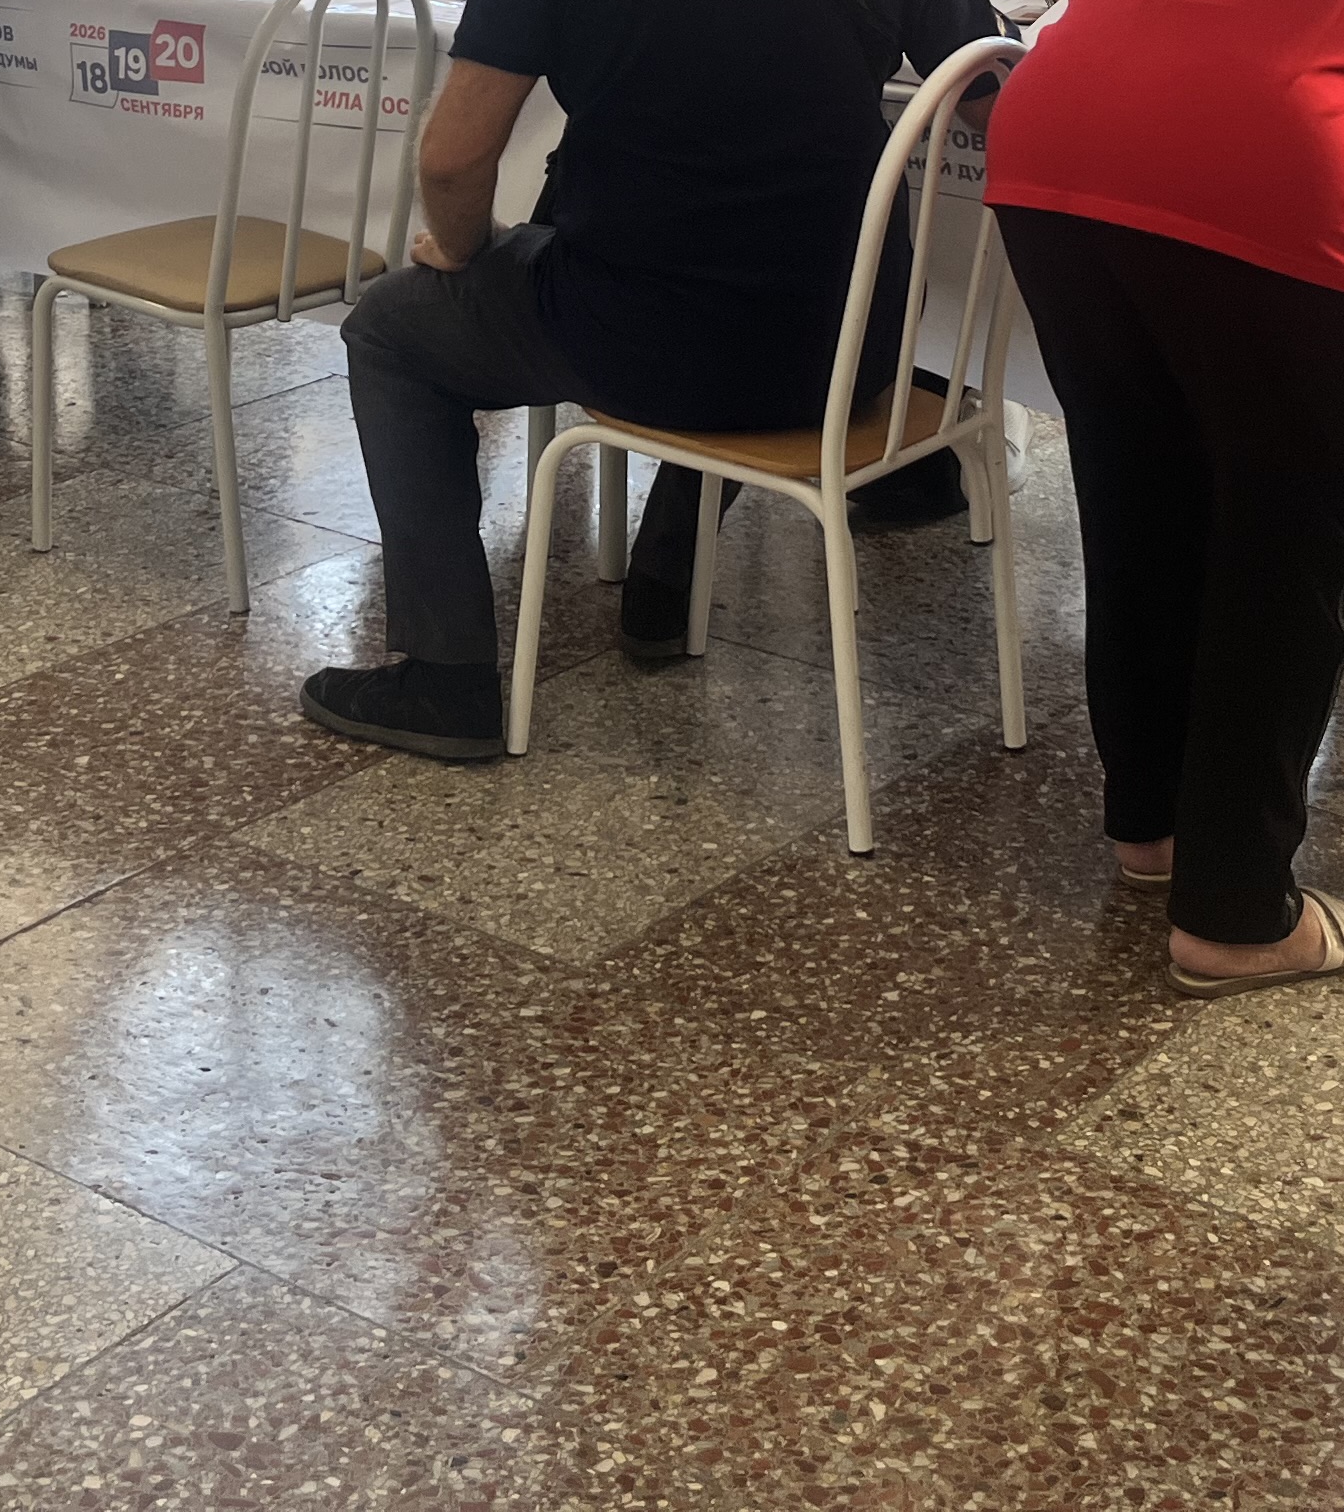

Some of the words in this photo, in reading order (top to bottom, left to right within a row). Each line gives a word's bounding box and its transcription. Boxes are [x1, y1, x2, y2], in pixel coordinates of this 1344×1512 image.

[69, 22, 107, 41] 2026
[76, 60, 107, 95] 18
[113, 47, 148, 82] 19
[155, 33, 200, 70] 20
[119, 96, 205, 122] СЕНТЯБРЯ
